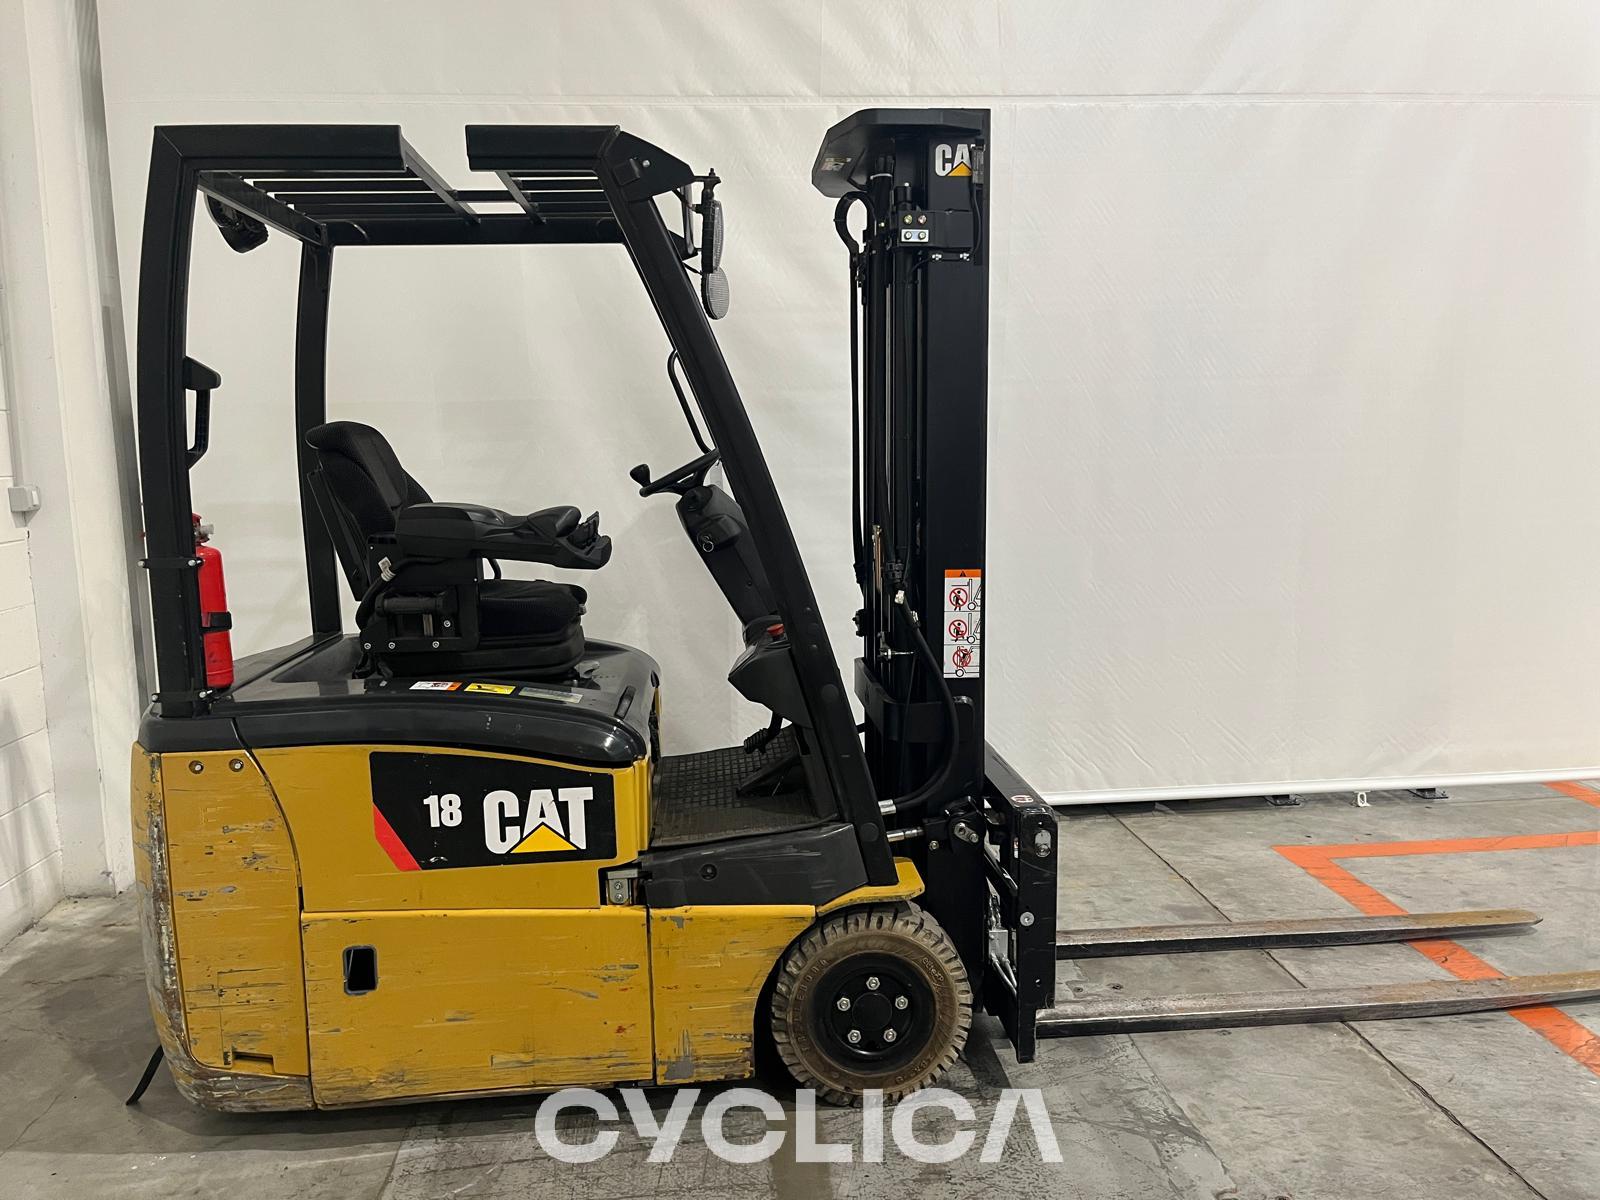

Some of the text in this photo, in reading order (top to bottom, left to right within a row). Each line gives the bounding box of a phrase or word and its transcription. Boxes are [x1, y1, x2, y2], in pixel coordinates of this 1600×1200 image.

[935, 143, 976, 177] CA
[423, 786, 594, 855] 18 CAT
